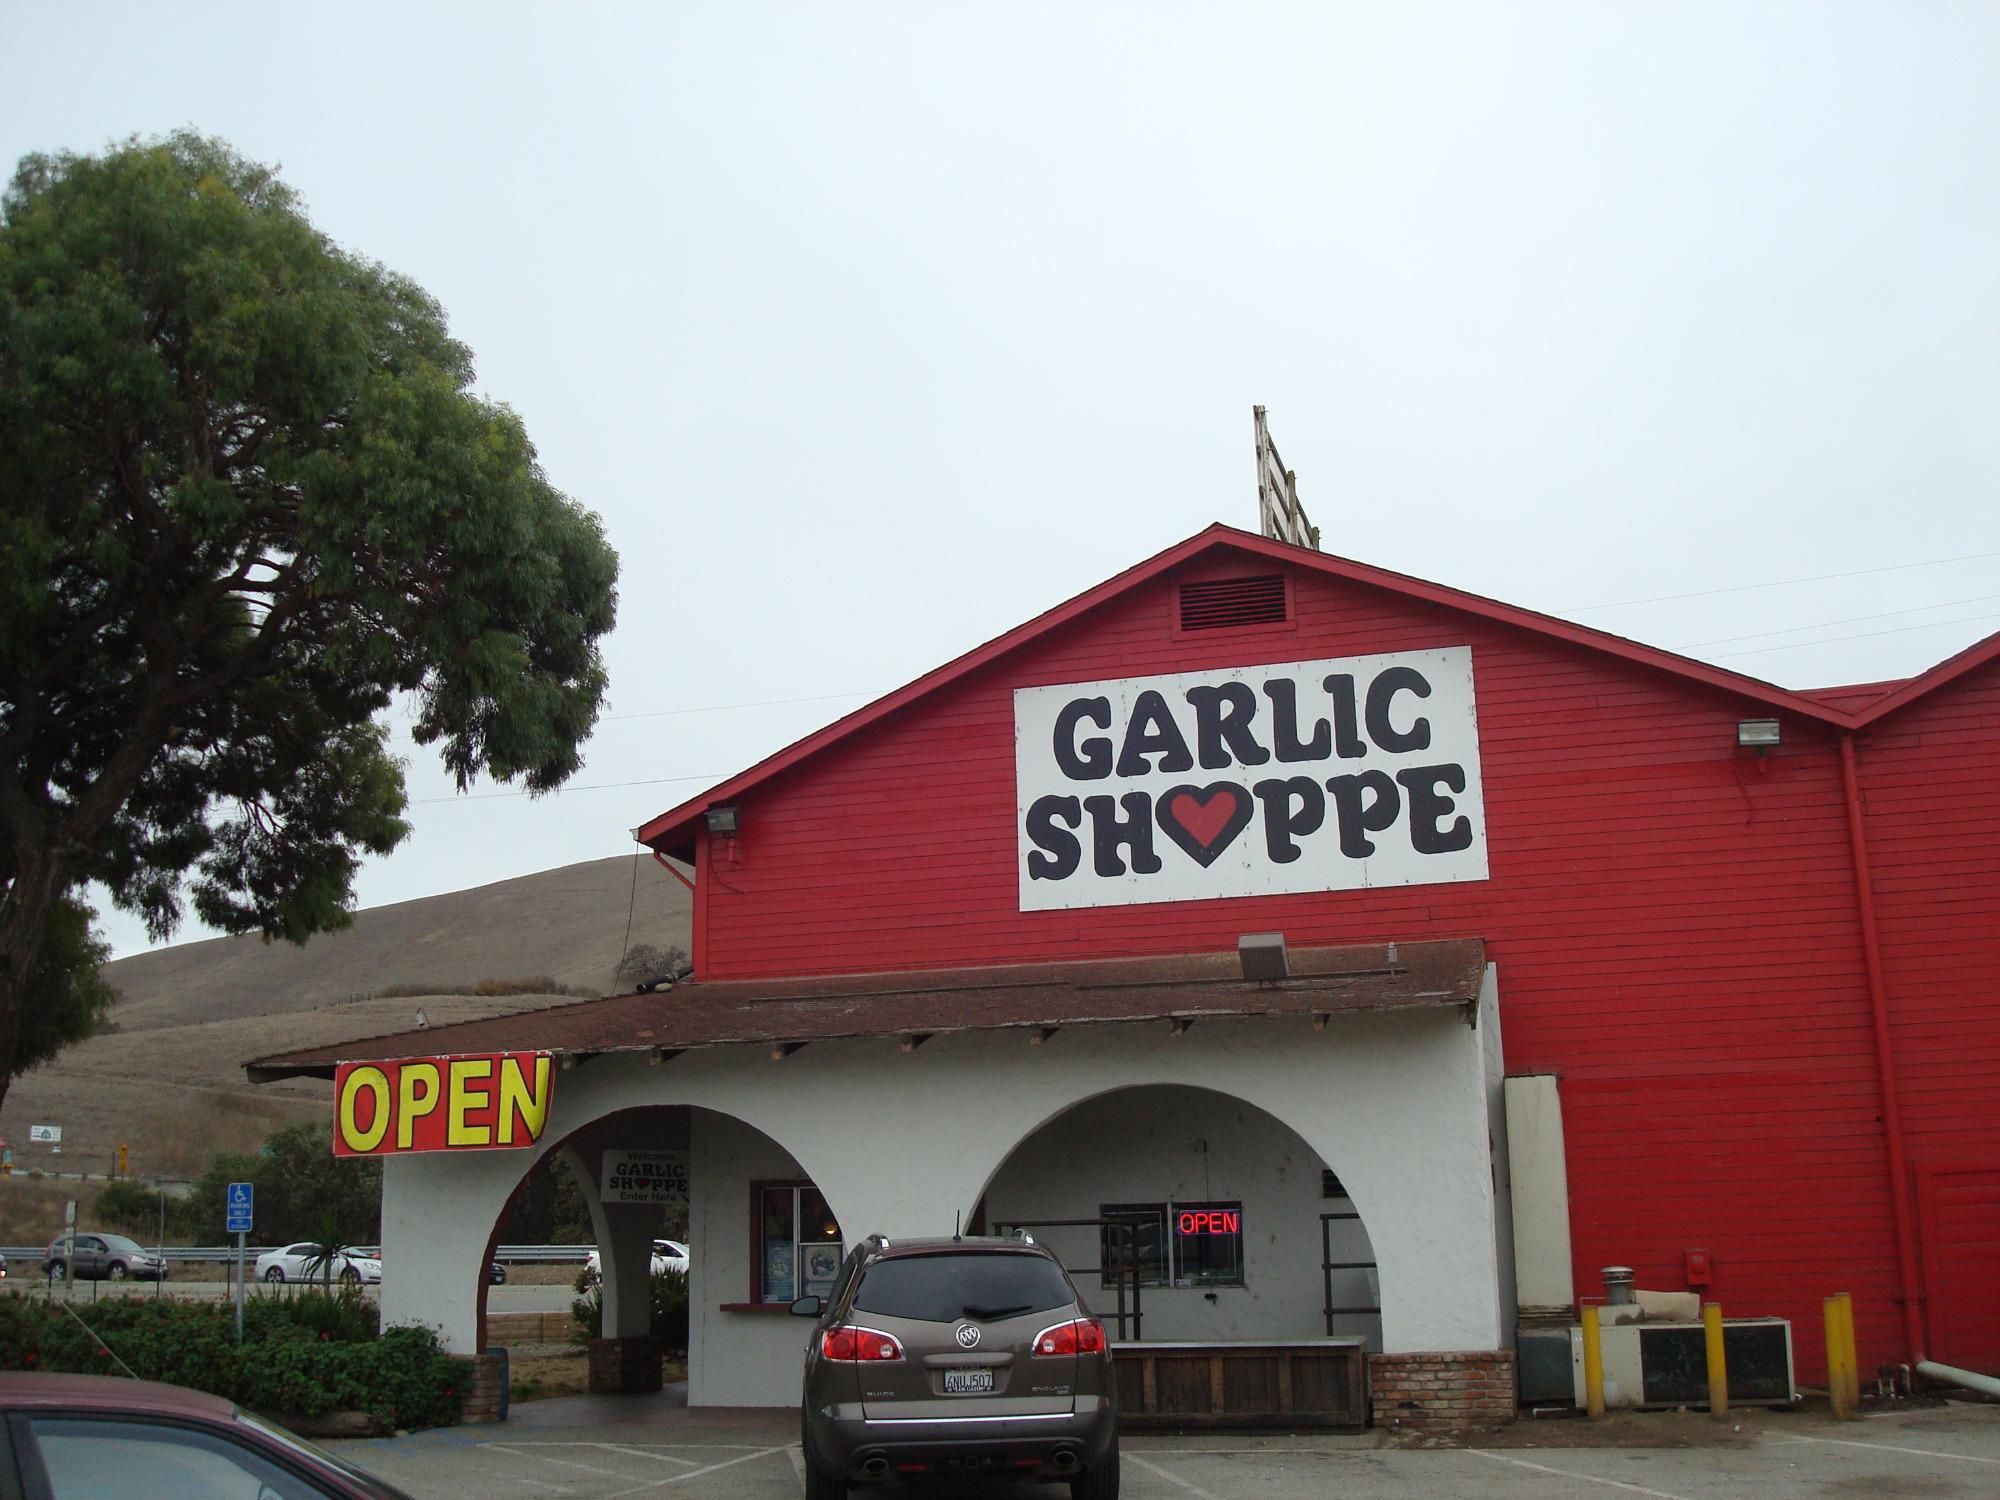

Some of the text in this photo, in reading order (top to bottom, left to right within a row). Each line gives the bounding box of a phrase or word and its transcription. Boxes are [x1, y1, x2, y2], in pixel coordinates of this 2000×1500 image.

[1053, 666, 1432, 781] GARLIC
[339, 1057, 551, 1152] OPEN
[628, 1152, 674, 1161] Welcome
[616, 1163, 684, 1177] GARLIC
[620, 1191, 677, 1201] Enter Here
[1180, 1212, 1238, 1233] OPEN
[946, 1374, 992, 1388] 6NUJ507
